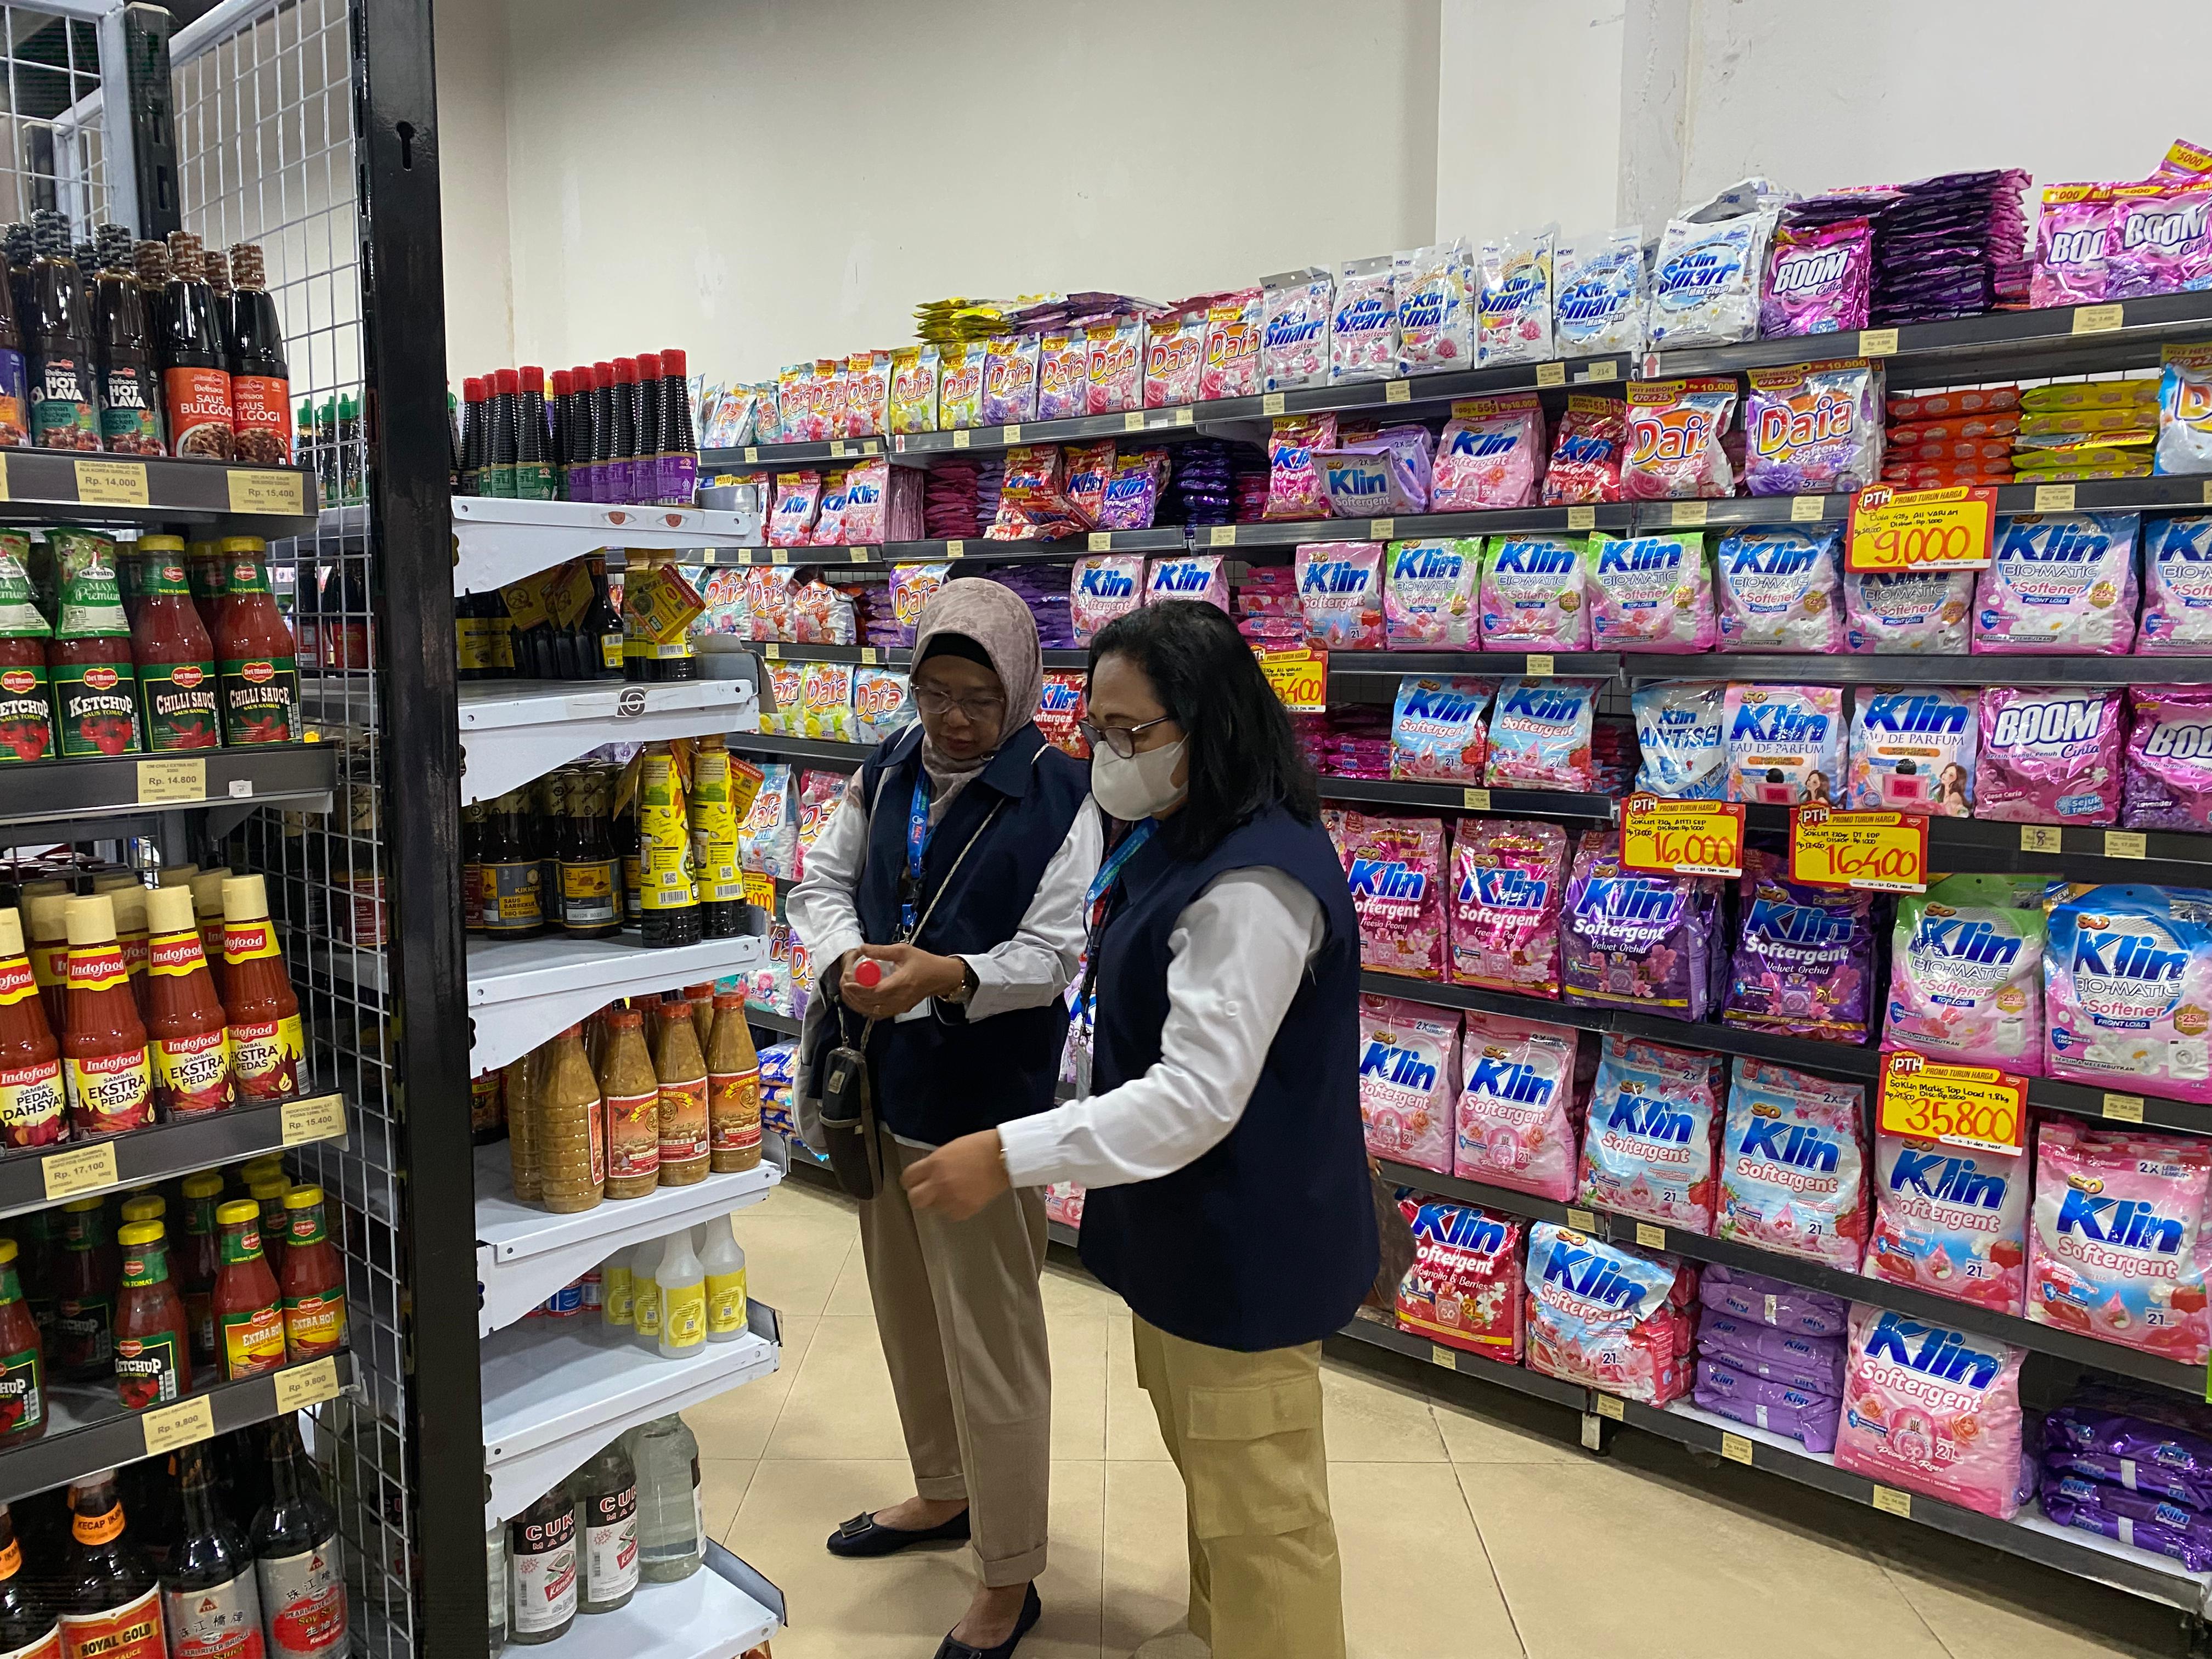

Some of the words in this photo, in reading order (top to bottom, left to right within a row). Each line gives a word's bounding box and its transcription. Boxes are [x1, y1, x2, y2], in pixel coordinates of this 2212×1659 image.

[1681, 252, 1717, 269] Klin
[1774, 252, 1849, 294] BOOM
[1207, 325, 1261, 365] Daia
[1089, 344, 1137, 383] Daia
[1148, 340, 1200, 377] Daia
[1827, 359, 1867, 370] 10.000
[45, 369, 76, 377] Delisaos
[1597, 367, 1610, 375] 214
[45, 377, 76, 388] HOT
[110, 385, 138, 396] HOT
[194, 385, 223, 394] Delisaos
[893, 370, 933, 402] Daia
[941, 369, 979, 400] Daia
[1701, 382, 1736, 393] 10.000
[47, 388, 83, 400] LAVA
[111, 396, 145, 408] LAVA
[196, 394, 224, 404] SAUS
[236, 402, 264, 410] SAUS
[1757, 396, 1854, 456] Daia
[1450, 430, 1523, 457] Klin
[1633, 416, 1713, 465] Daia
[1448, 454, 1508, 469] Softergent
[86, 477, 101, 486] Rp.
[105, 478, 136, 487] 14,000
[1328, 466, 1387, 496] Klin
[249, 488, 263, 497] Rp.
[1335, 494, 1391, 509] Softergent
[1864, 488, 1893, 507] PTH
[1940, 490, 1962, 499] HARGA
[1997, 523, 2113, 563] Klin
[1494, 540, 1577, 575] Klin
[1597, 539, 1684, 575] Klin
[1154, 562, 1210, 591] Klin
[1302, 562, 1369, 594] Klin
[1498, 575, 1567, 586] BIO-MATIC
[1602, 571, 1678, 586] BIO-MATIC
[2002, 565, 2098, 578] BIO-MATIC
[1081, 568, 1135, 598] Klin
[1731, 574, 1809, 589] BIO-MATIC
[706, 576, 747, 610] Daia
[1304, 594, 1365, 610] Softergent
[1351, 629, 1361, 639] 21
[230, 690, 259, 709] CHILLI
[261, 686, 290, 706] SAUCE
[805, 674, 848, 707] Daia
[857, 681, 904, 716] Daia
[70, 696, 133, 718] KETCHUP
[156, 694, 190, 716] CHILLI
[191, 691, 215, 710] SAUCE
[823, 705, 844, 715] Fruity
[1404, 687, 1479, 722] Klin
[874, 714, 890, 724] Putih
[1400, 719, 1466, 738] Softergent
[1502, 716, 1575, 737] Softergent
[1729, 704, 1830, 743] Klin
[1991, 699, 2107, 748] BOOM
[1730, 743, 1754, 753] EAU
[1757, 744, 1771, 753] DE
[1773, 744, 1825, 753] PARFUM
[2061, 743, 2100, 759] Cinta
[1633, 798, 1656, 811] PTH
[2070, 804, 2103, 814] Tangan
[2072, 798, 2101, 808] Sejuk
[1458, 867, 1549, 910] Klin
[1573, 877, 1678, 924] Klin
[1458, 905, 1541, 927] Softergent
[1572, 918, 1666, 943] Softergent
[152, 944, 202, 963] Indofood
[2072, 929, 2193, 984] Klin
[71, 957, 125, 979] Indofood
[1766, 960, 1796, 973] Velvet
[1798, 963, 1829, 975] Orchid
[1911, 957, 2010, 981] BIO-MATIC
[2098, 1019, 2124, 1028] FRONT
[2125, 1020, 2148, 1028] LOAD
[168, 1031, 221, 1055] Indofood
[236, 1042, 262, 1051] SAMBAL
[86, 1052, 142, 1075] Indofood
[170, 1054, 225, 1079] EKSTRA
[184, 1052, 213, 1063] SAMBAL
[236, 1059, 268, 1071] PEDAS
[1895, 1057, 1925, 1071] PTH
[88, 1074, 145, 1099] EKSTRA
[103, 1072, 133, 1084] SAMBAL
[182, 1070, 219, 1086] PEDAS
[16, 1088, 54, 1106] PEDAS
[20, 1083, 49, 1097] SAMBAL
[100, 1090, 139, 1107] PEDAS
[1947, 1086, 1961, 1096] Top
[1963, 1088, 1984, 1097] Load
[3, 1092, 63, 1121] DAHSYAT
[306, 1116, 332, 1126] 15.400
[1738, 1115, 1841, 1174] Klin
[74, 1162, 104, 1175] 17,100
[1737, 1159, 1838, 1194] Softergent
[1412, 1203, 1508, 1256] Klin
[1809, 1223, 1822, 1235] 21
[2056, 1189, 2186, 1256] Klin
[2057, 1235, 2179, 1280] Softergent
[1543, 1241, 1648, 1309] Klin
[292, 1316, 318, 1330] EXTRA
[320, 1311, 335, 1325] HOT
[1863, 1310, 2002, 1392] Klin
[289, 1384, 302, 1392] Rp.
[1859, 1360, 1982, 1414] Softergent
[157, 1425, 172, 1435] Rp.
[81, 1639, 119, 1656] ROYAL
[123, 1623, 151, 1643] GOLD
